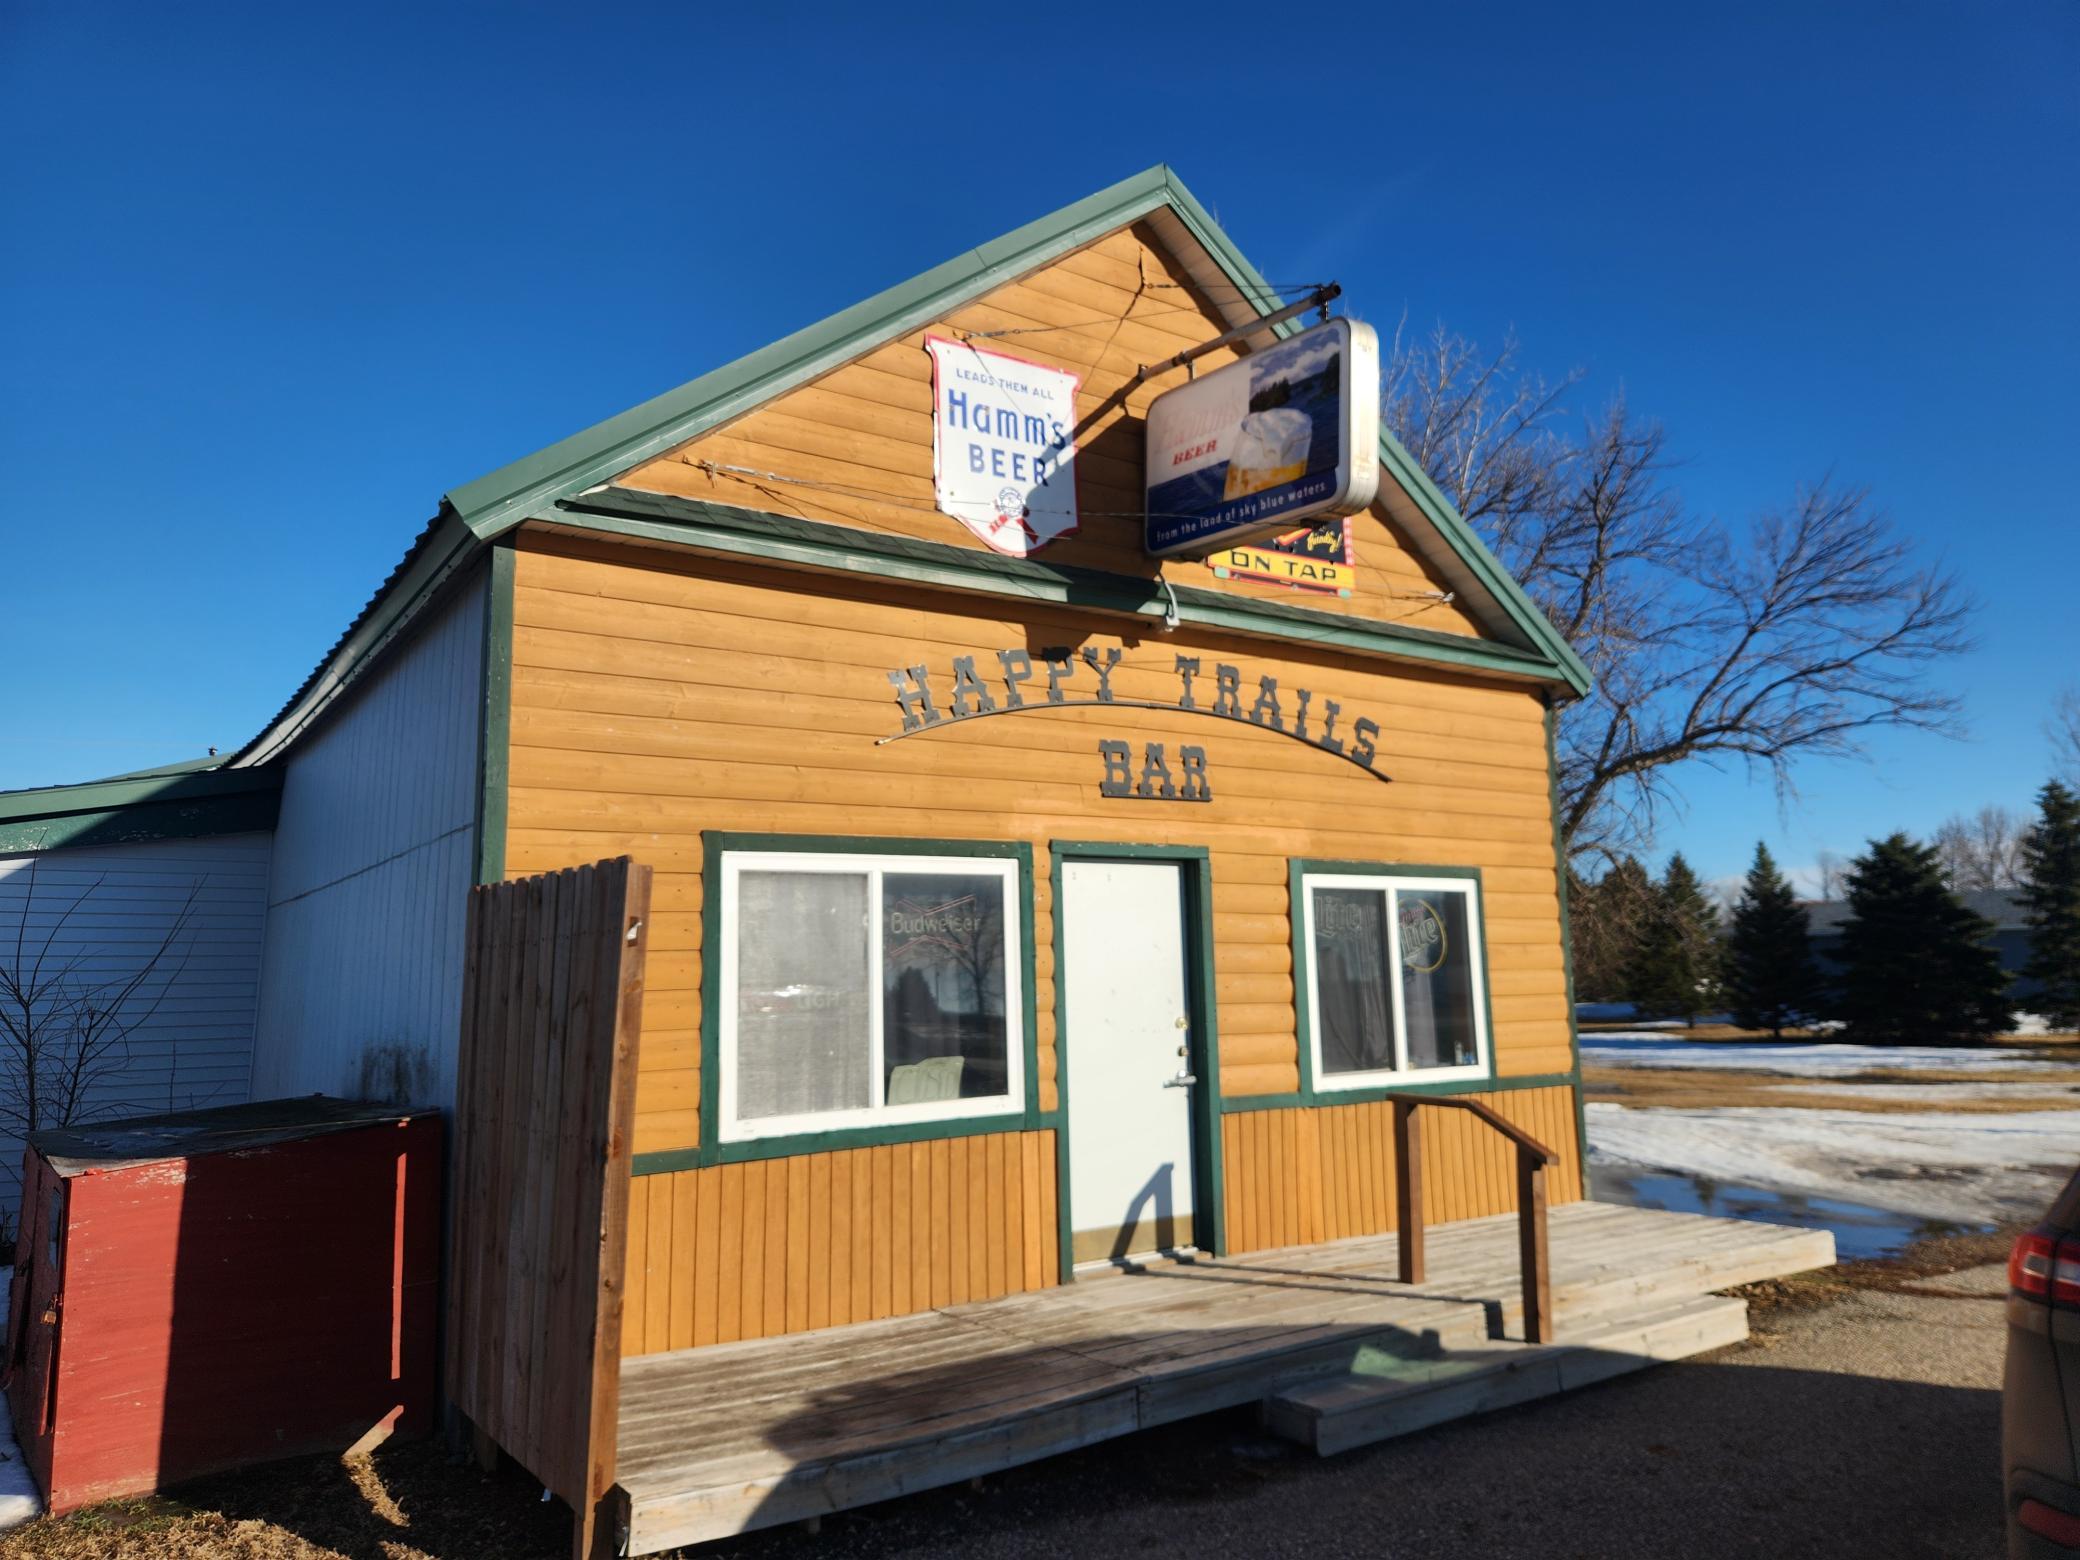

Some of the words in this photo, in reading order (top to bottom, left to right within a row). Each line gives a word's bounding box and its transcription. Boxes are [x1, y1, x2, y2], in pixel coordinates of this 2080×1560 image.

[956, 367, 996, 386] LEADS
[999, 378, 1029, 395] THEM
[1033, 387, 1054, 401] ALL
[948, 388, 1066, 451] Hamm's
[969, 443, 1048, 487] BEER
[1172, 439, 1217, 466] BEER
[1156, 527, 1178, 543] from
[1181, 518, 1197, 534] the
[1200, 511, 1222, 529] land
[1225, 506, 1236, 521] of
[1240, 501, 1257, 518] sky
[1260, 493, 1284, 511] blue
[1288, 481, 1326, 502] waters
[1231, 550, 1271, 572] ON
[1285, 561, 1337, 580] TAP
[887, 647, 1122, 732] HAPPY
[1175, 653, 1381, 768] TRAILS
[1099, 739, 1211, 800] BAR
[891, 911, 982, 935] Budweiser
